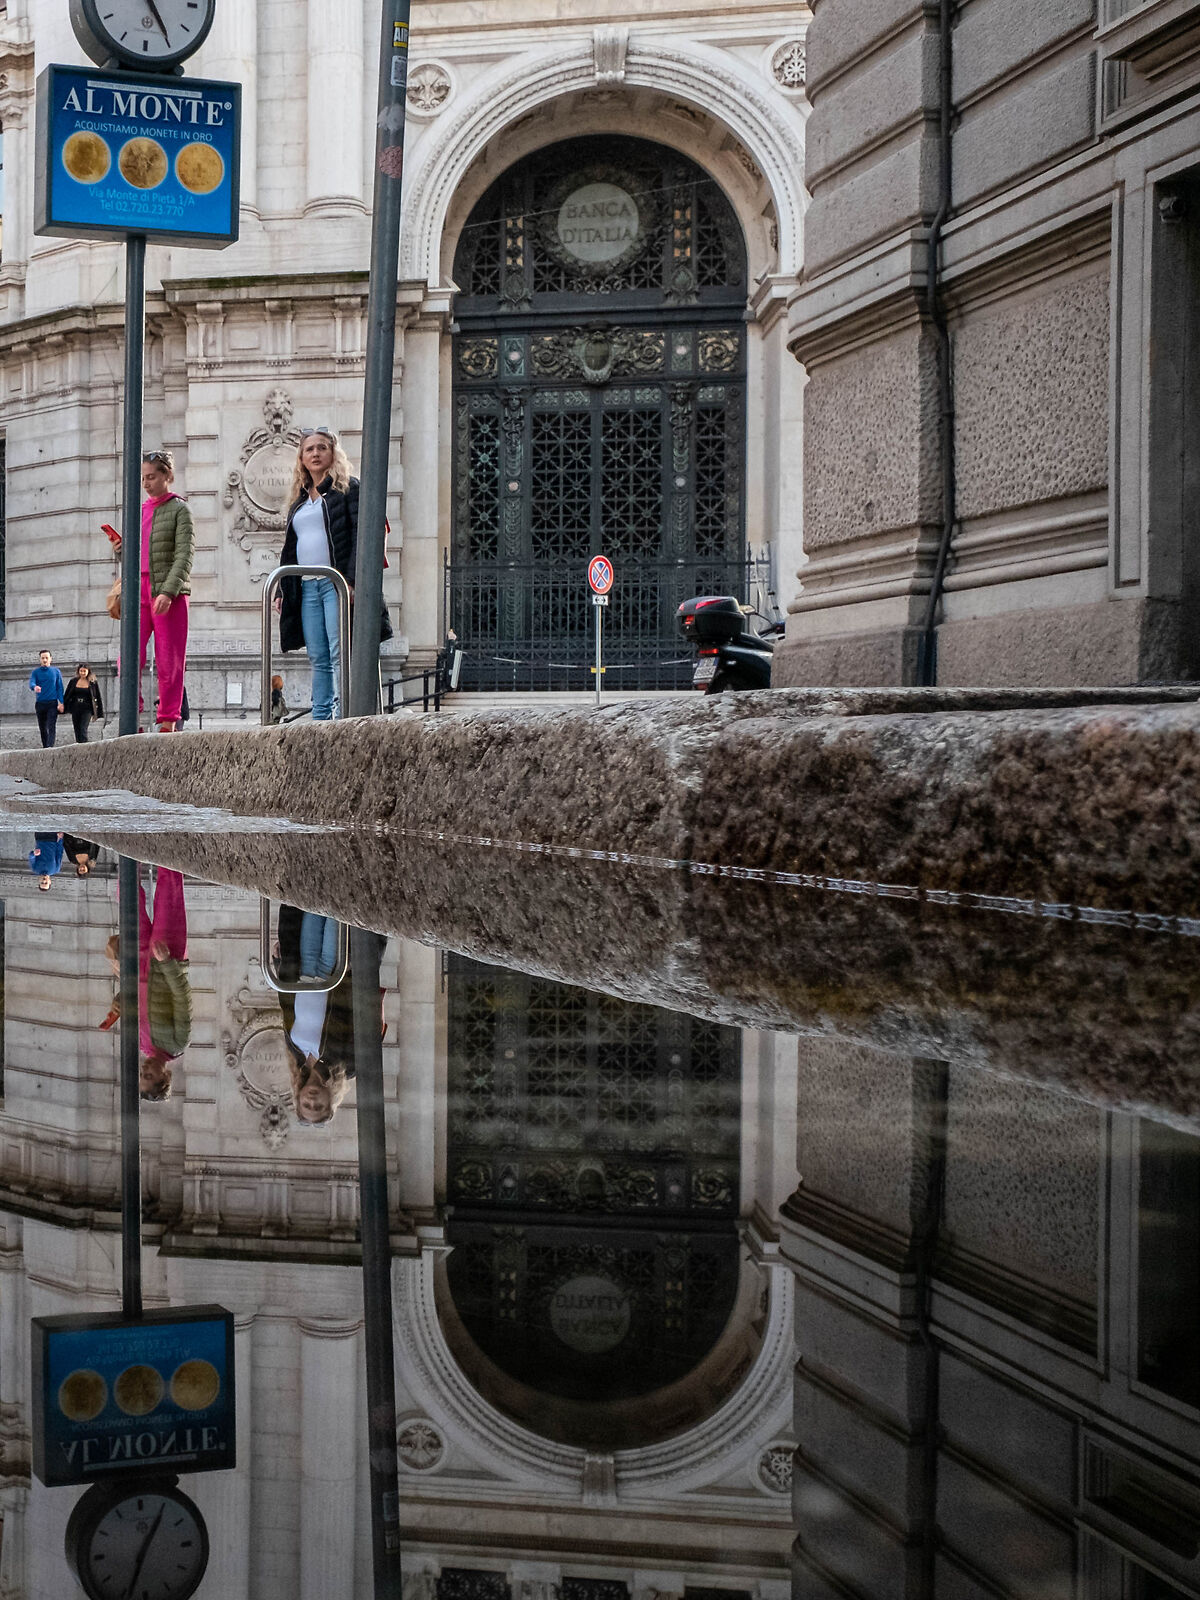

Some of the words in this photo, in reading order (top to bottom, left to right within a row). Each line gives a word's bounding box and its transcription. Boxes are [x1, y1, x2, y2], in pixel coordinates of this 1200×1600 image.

[62, 87, 103, 115] AL
[74, 120, 138, 135] ACQUISTIAMO
[140, 127, 179, 139] MONETE
[180, 131, 191, 140] IN
[192, 132, 213, 142] ORO
[88, 187, 104, 198] Via
[106, 188, 139, 201] Monte
[140, 190, 150, 202] di
[100, 199, 114, 210] Tel
[566, 201, 632, 219] BANCA
[562, 227, 634, 243] D'ITALIA
